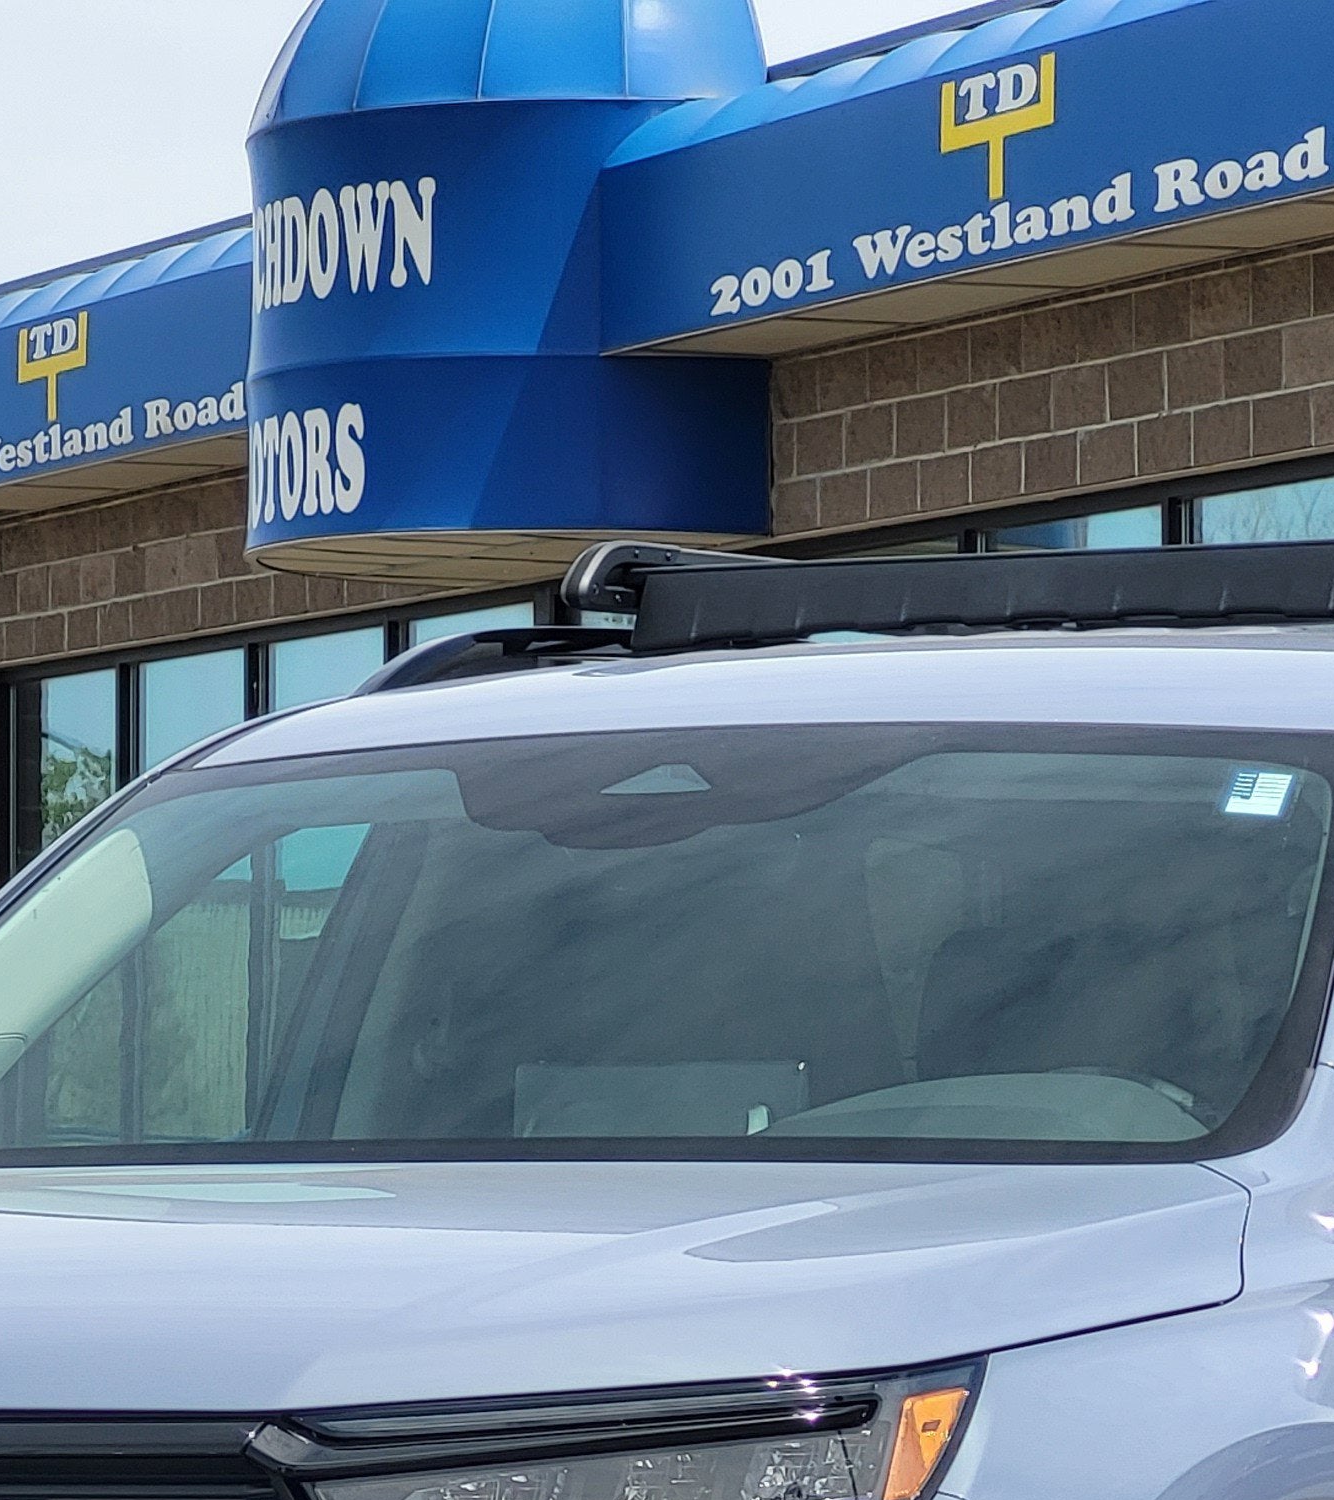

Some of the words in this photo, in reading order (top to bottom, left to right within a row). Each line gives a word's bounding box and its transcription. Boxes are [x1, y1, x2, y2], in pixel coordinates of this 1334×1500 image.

[954, 62, 1038, 123] TD
[709, 249, 835, 317] 2001
[853, 173, 1135, 280] Westland
[1153, 126, 1329, 213] Road
[29, 316, 78, 362] TD
[144, 381, 247, 438] Road
